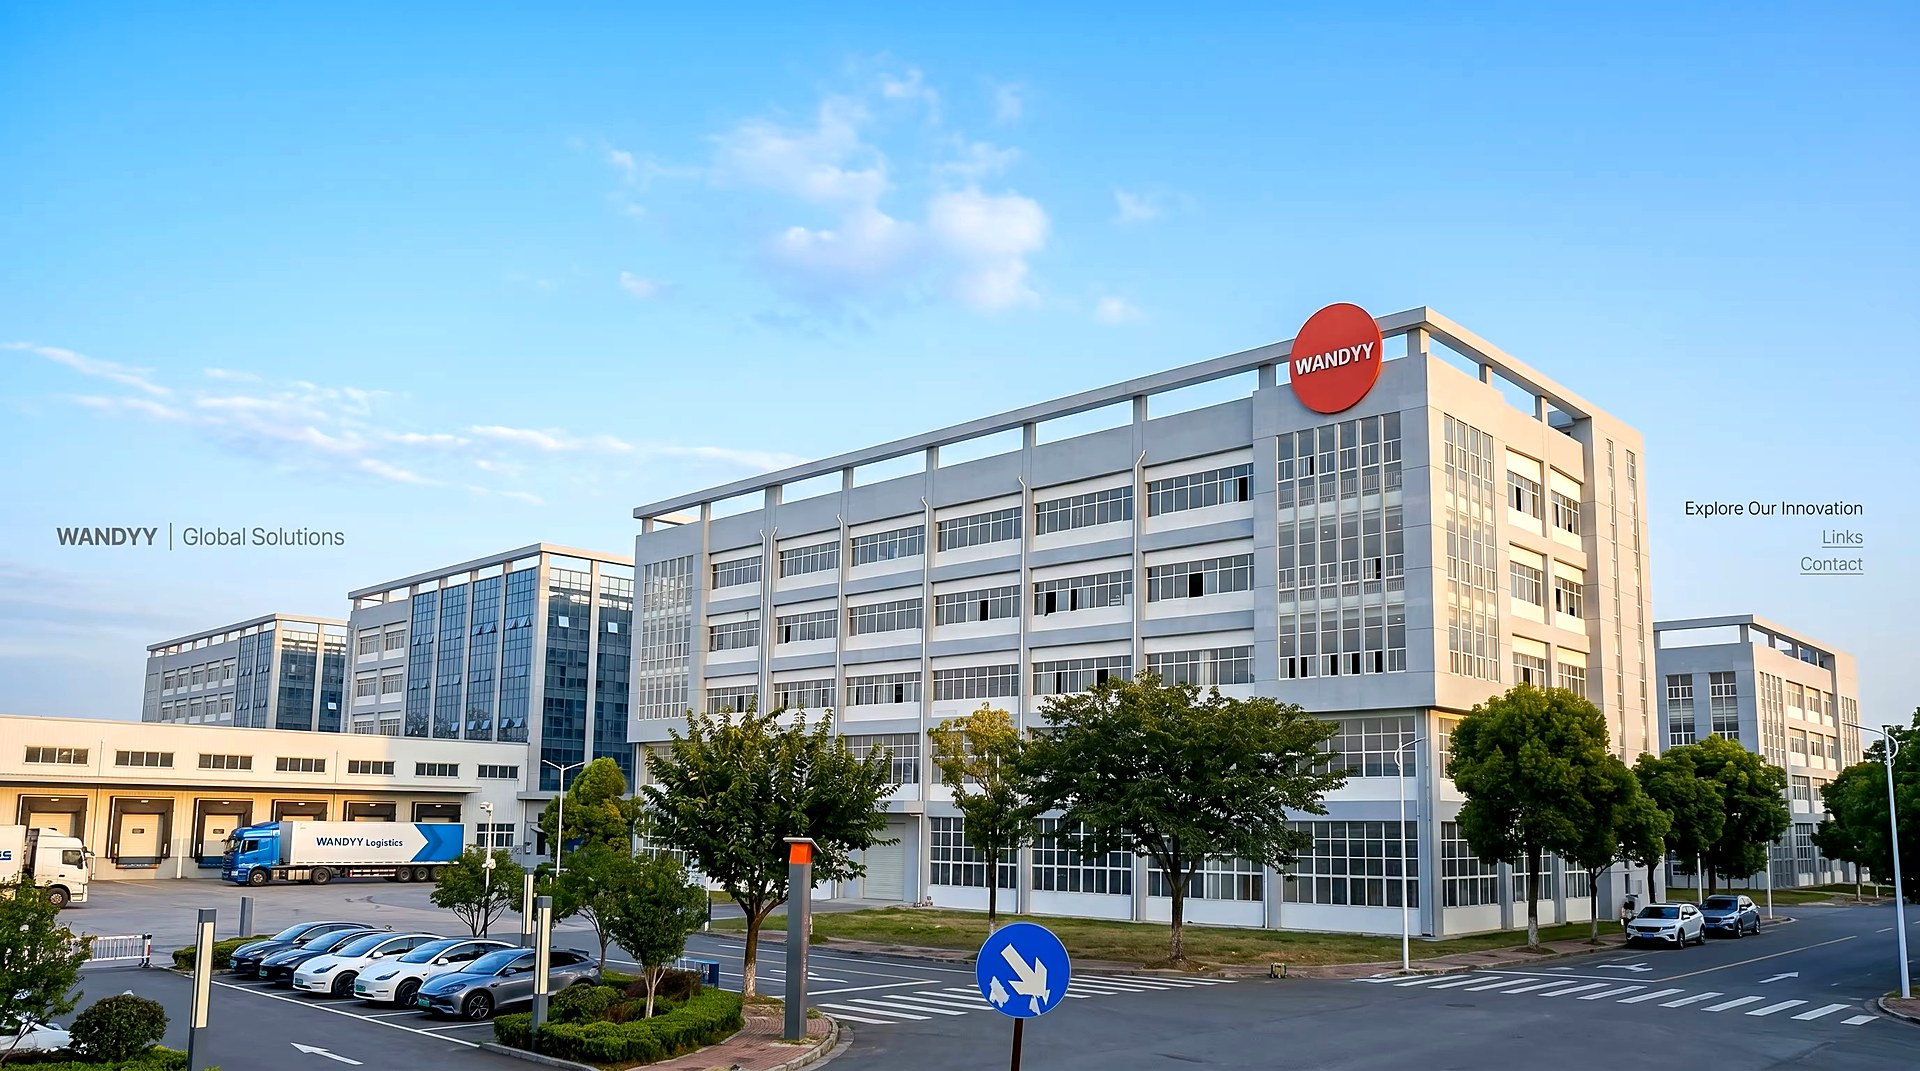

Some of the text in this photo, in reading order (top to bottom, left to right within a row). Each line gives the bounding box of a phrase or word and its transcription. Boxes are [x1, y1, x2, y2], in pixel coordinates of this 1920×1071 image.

[1295, 341, 1375, 376] WANDYY
[316, 837, 404, 849] WANDYY Logistics
